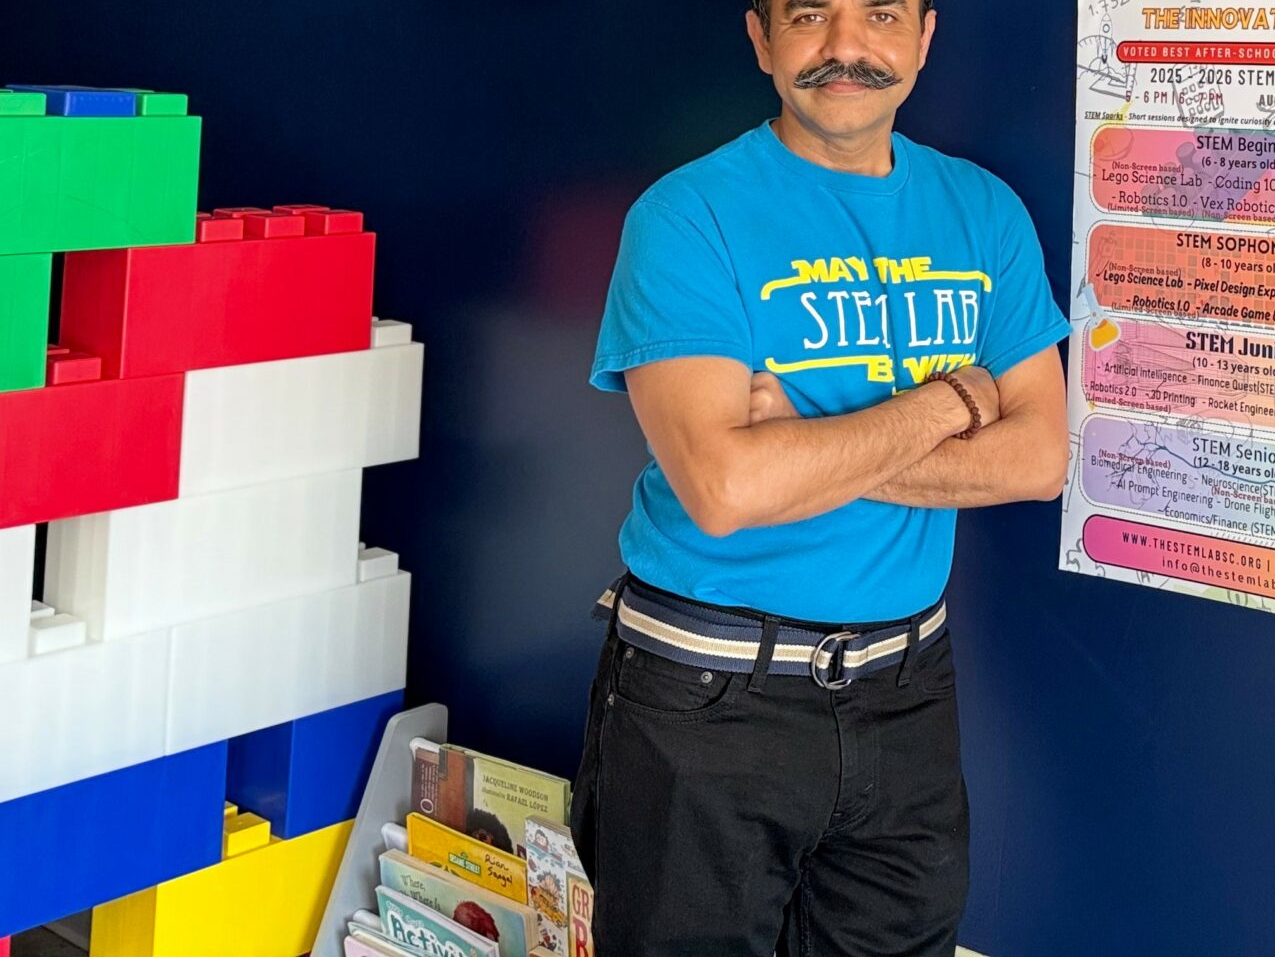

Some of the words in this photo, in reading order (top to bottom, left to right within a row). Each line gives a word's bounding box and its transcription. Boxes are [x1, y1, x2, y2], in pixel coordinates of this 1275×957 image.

[1142, 8, 1180, 30] THE
[1124, 47, 1157, 57] VOTED
[1163, 48, 1189, 57] BEST
[1150, 68, 1182, 83] 2025
[1200, 69, 1232, 85] 2026
[1238, 70, 1275, 86] STEM
[1085, 112, 1101, 120] STEM
[1102, 113, 1123, 121] Sparks
[1128, 113, 1146, 121] Short
[1148, 114, 1175, 122] sessions
[1177, 115, 1207, 124] designed
[1218, 116, 1234, 125] ignite
[1236, 117, 1272, 127] curiosity
[1197, 136, 1233, 151] STEM
[1102, 170, 1128, 184] Lego
[1132, 171, 1177, 185] Science
[1181, 174, 1202, 187] Lab
[1215, 176, 1260, 194] Coding
[1119, 191, 1169, 206] Robotics
[1172, 195, 1188, 207] 1.0
[1200, 196, 1224, 210] Vex
[1177, 233, 1212, 249] STEM
[791, 256, 869, 283] MAY
[873, 257, 931, 284] THE
[1104, 270, 1125, 285] Lego
[1127, 273, 1164, 287] Science
[1166, 276, 1183, 288] Lab
[1194, 279, 1219, 292] Pixel
[1220, 280, 1255, 297] Design
[904, 290, 979, 347] LAB
[1132, 296, 1175, 311] Robotics
[1203, 304, 1238, 318] Arcade
[1241, 307, 1270, 321] Game
[1186, 332, 1234, 354] STEM
[1193, 438, 1231, 457] STEM
[1122, 532, 1262, 569] WWW.THESTEMLABSC.ORG
[482, 775, 517, 792] JACQUELINE
[520, 783, 548, 801] WOODSON
[506, 794, 528, 808] RAFAEL
[530, 798, 548, 813] LÓPEZ
